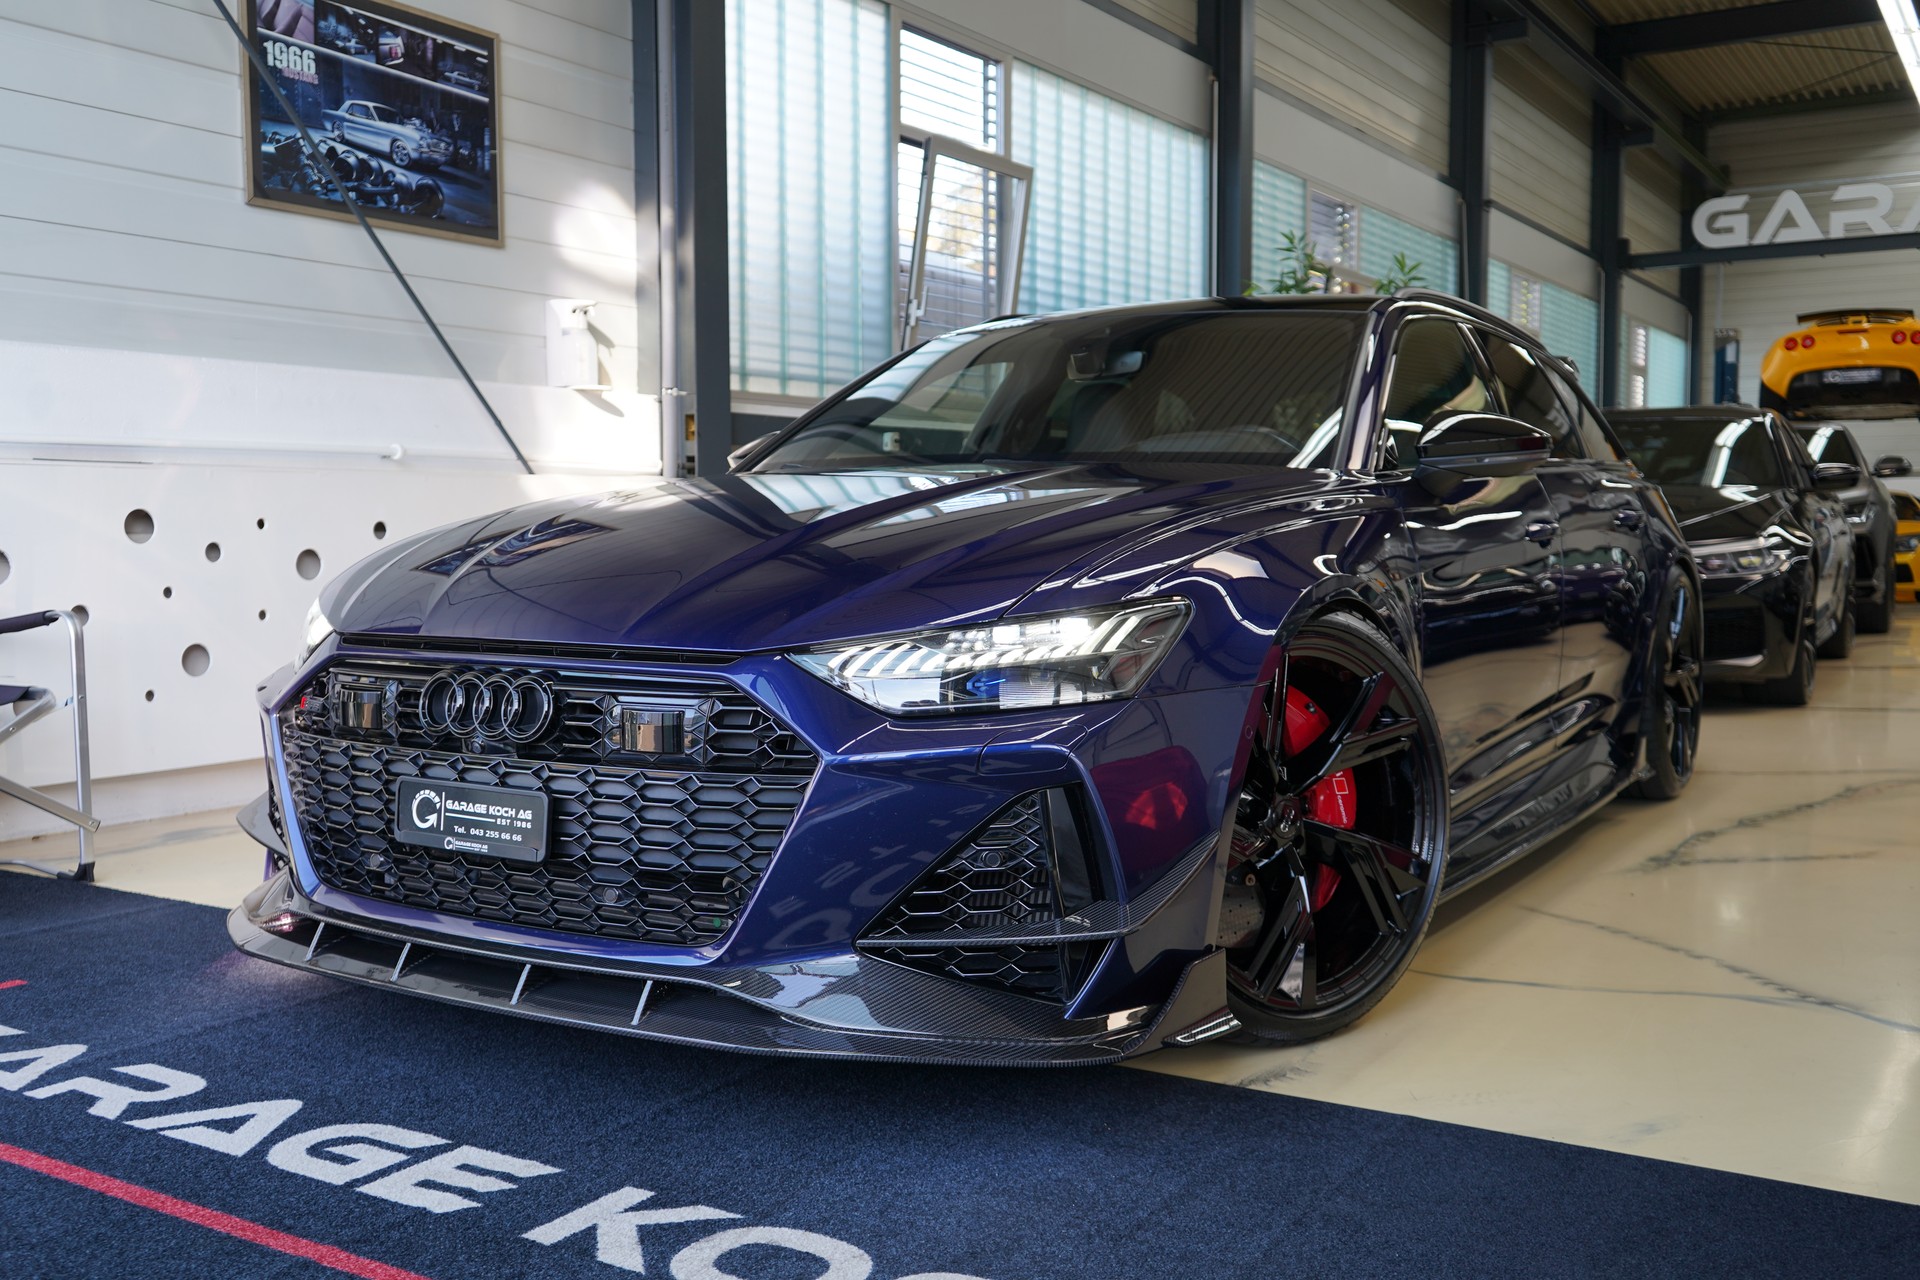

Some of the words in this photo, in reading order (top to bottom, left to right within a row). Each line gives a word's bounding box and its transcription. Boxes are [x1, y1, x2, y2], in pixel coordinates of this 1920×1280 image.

[263, 40, 316, 75] 1966
[445, 800, 488, 814] GARAGE
[488, 805, 516, 818] KOCH
[517, 809, 533, 820] AG
[1337, 795, 1348, 824] ceramic
[453, 825, 467, 834] Tel.
[469, 828, 484, 836] 043
[485, 830, 500, 839] 255
[500, 832, 511, 840] 66
[511, 834, 522, 842] 66
[496, 818, 511, 826] EST
[513, 820, 532, 829] 1986
[0, 1024, 564, 1214] ARAGE
[520, 1186, 1000, 1280] KO
